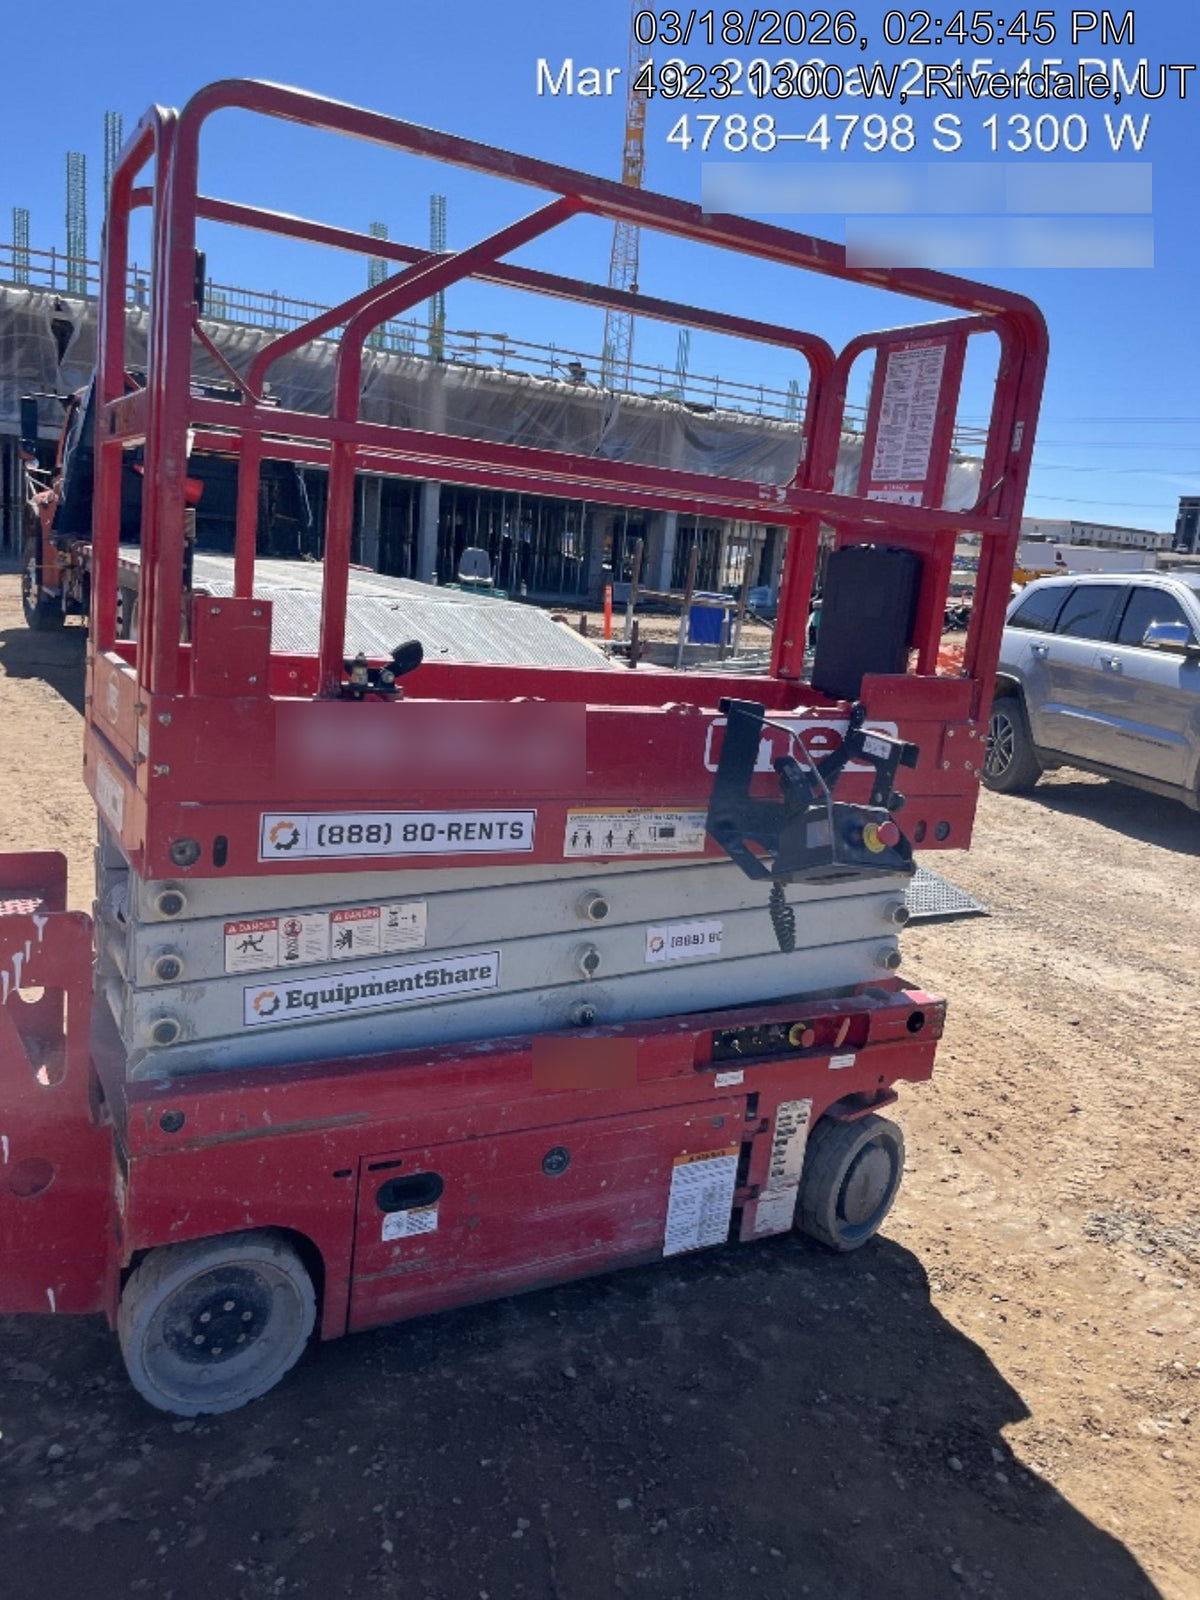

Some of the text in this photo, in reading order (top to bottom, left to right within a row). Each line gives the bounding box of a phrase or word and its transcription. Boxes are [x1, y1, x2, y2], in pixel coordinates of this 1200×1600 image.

[317, 822, 525, 847] (888) 80-RENTS
[285, 965, 493, 1010] EquipmentShare
